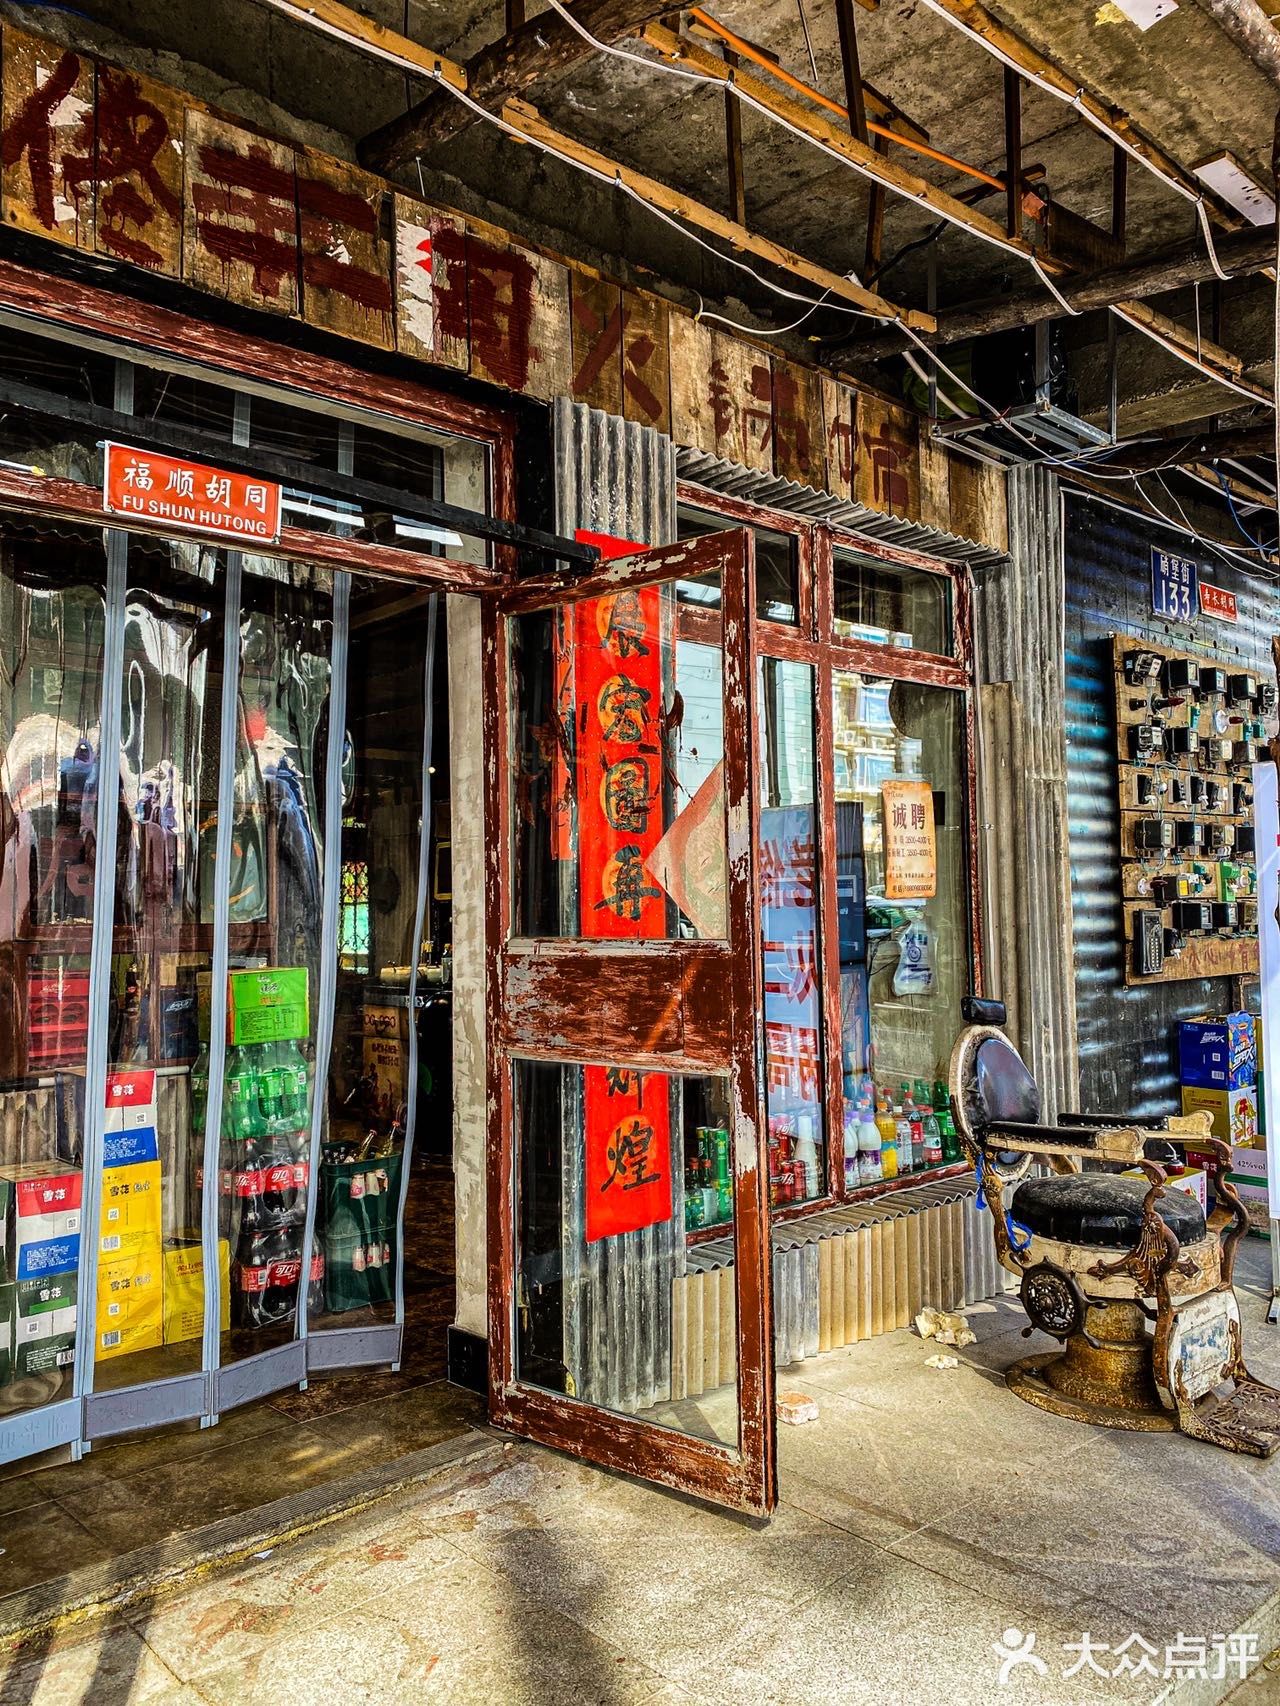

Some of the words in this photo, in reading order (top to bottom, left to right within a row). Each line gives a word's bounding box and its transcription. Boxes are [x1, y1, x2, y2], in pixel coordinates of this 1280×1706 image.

[122, 457, 268, 514] 福顺胡同
[122, 494, 145, 511] FU
[148, 499, 196, 522] SHUN
[199, 511, 268, 535] HUTONG
[1161, 579, 1190, 622] 133
[892, 802, 926, 831] 诚聘
[112, 1083, 136, 1097] 雪花
[42, 1187, 67, 1203] 雪花
[109, 1183, 131, 1198] 雪花
[39, 1285, 63, 1302] 雪花
